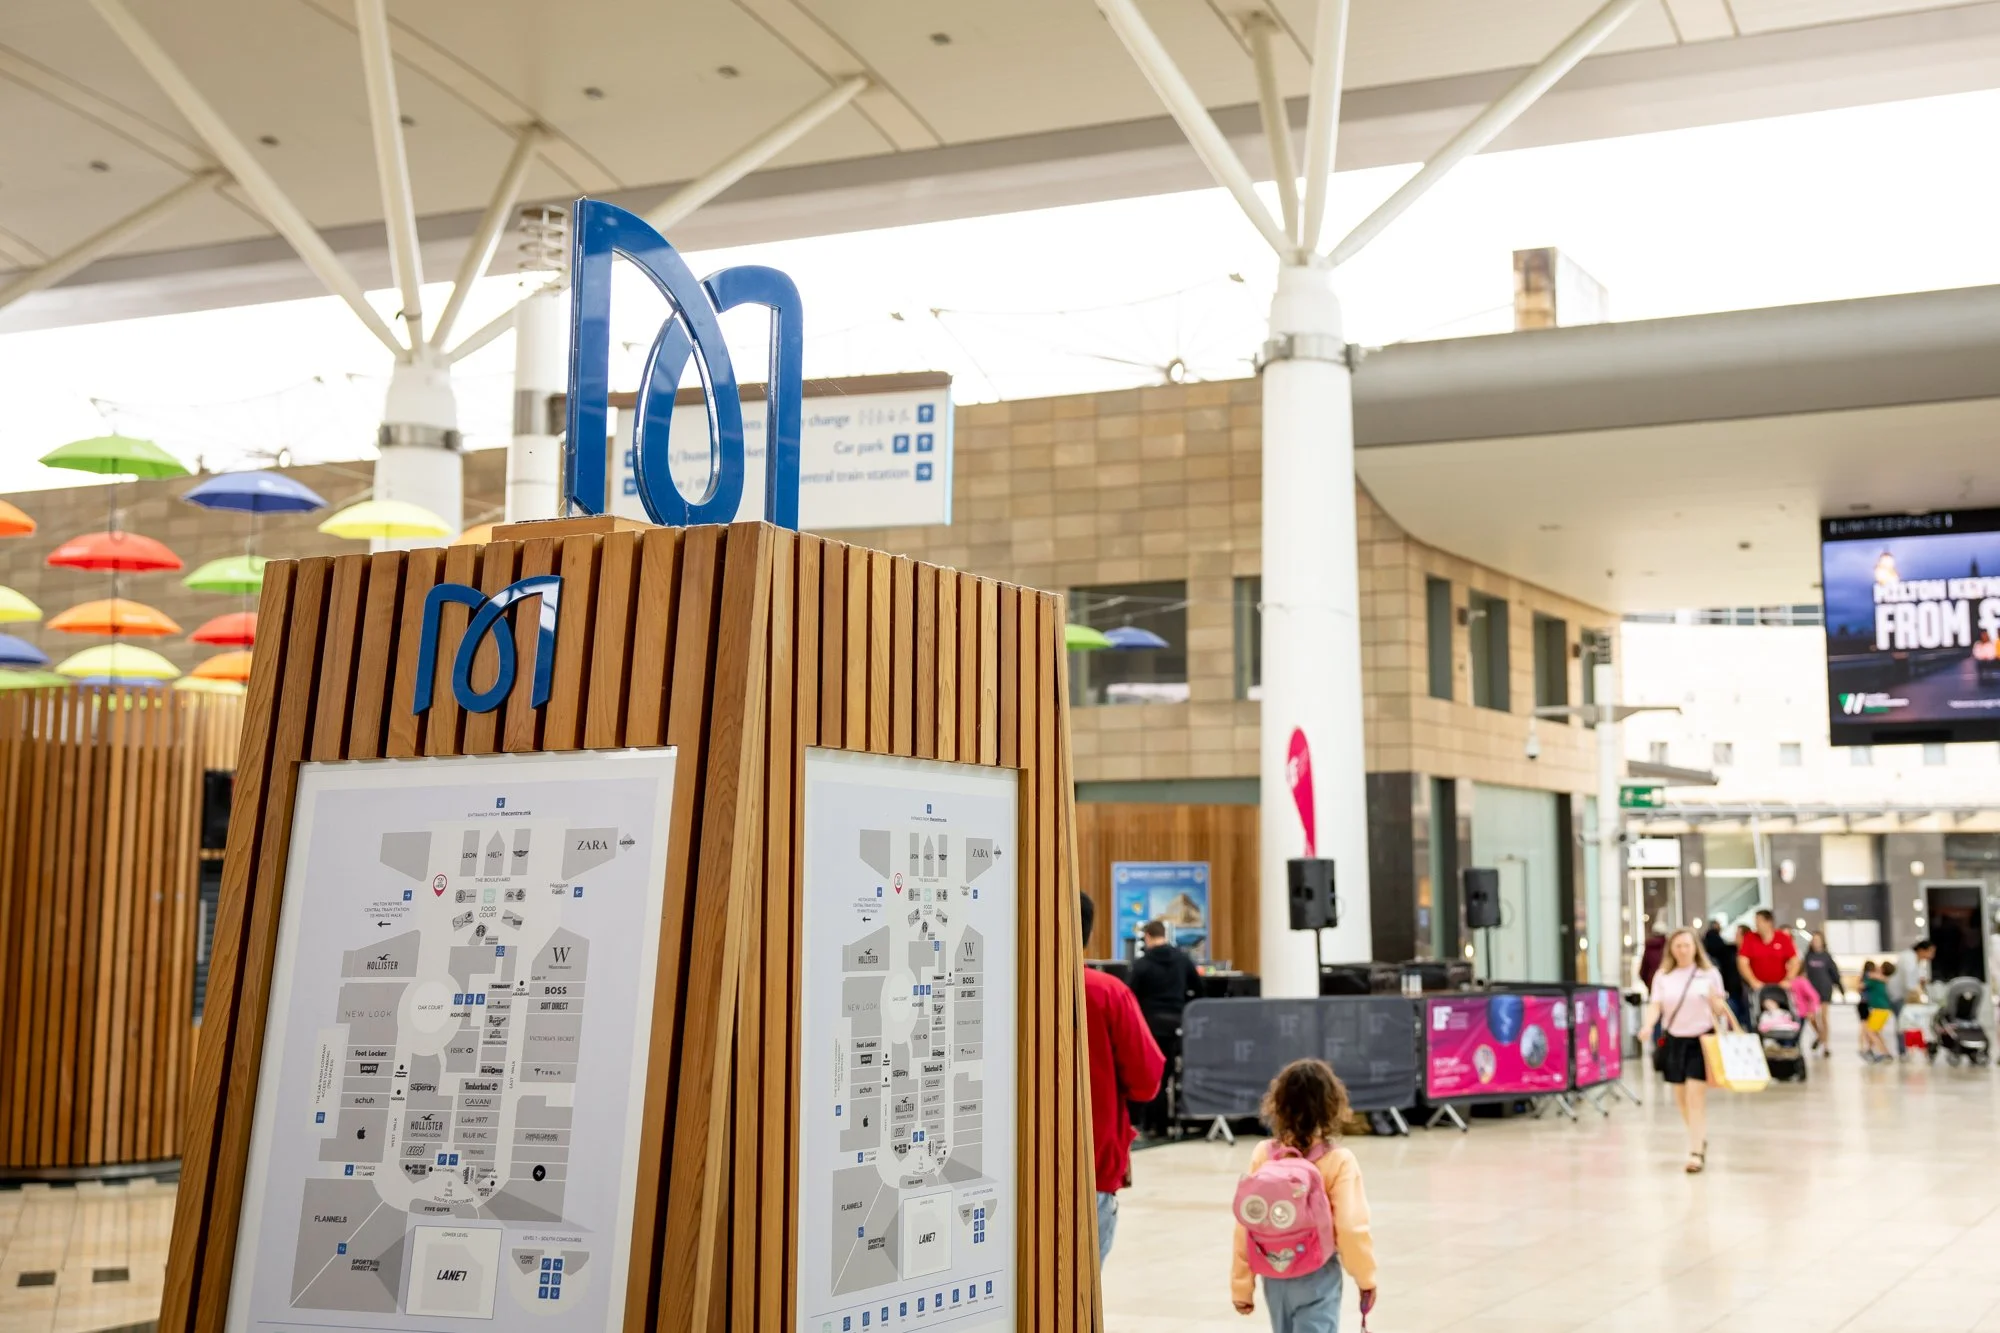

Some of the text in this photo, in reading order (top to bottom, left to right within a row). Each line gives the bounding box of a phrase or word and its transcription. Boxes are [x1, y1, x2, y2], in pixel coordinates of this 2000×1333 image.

[800, 470, 833, 484] entral
[1875, 600, 1972, 651] FROM
[577, 840, 608, 850] ZARA
[972, 848, 989, 858] ZARA
[964, 942, 975, 956] W
[552, 946, 572, 963] W
[858, 955, 878, 964] HOLLISTER
[367, 961, 398, 970] HOLLISTER
[545, 986, 567, 995] BOSS
[847, 1003, 860, 1011] NEW
[345, 1010, 392, 1018] NEW LOOK
[410, 1083, 436, 1092] Superdry
[465, 1082, 491, 1090] Timberland
[895, 1103, 914, 1113] HOLLISTER
[411, 1121, 443, 1131] HOLLISTER
[406, 1145, 425, 1156] LEGO
[841, 1201, 863, 1211] FLANNELS
[314, 1215, 347, 1223] FLANNELS
[919, 1232, 936, 1244] LANE7
[436, 1270, 467, 1282] LANE7
